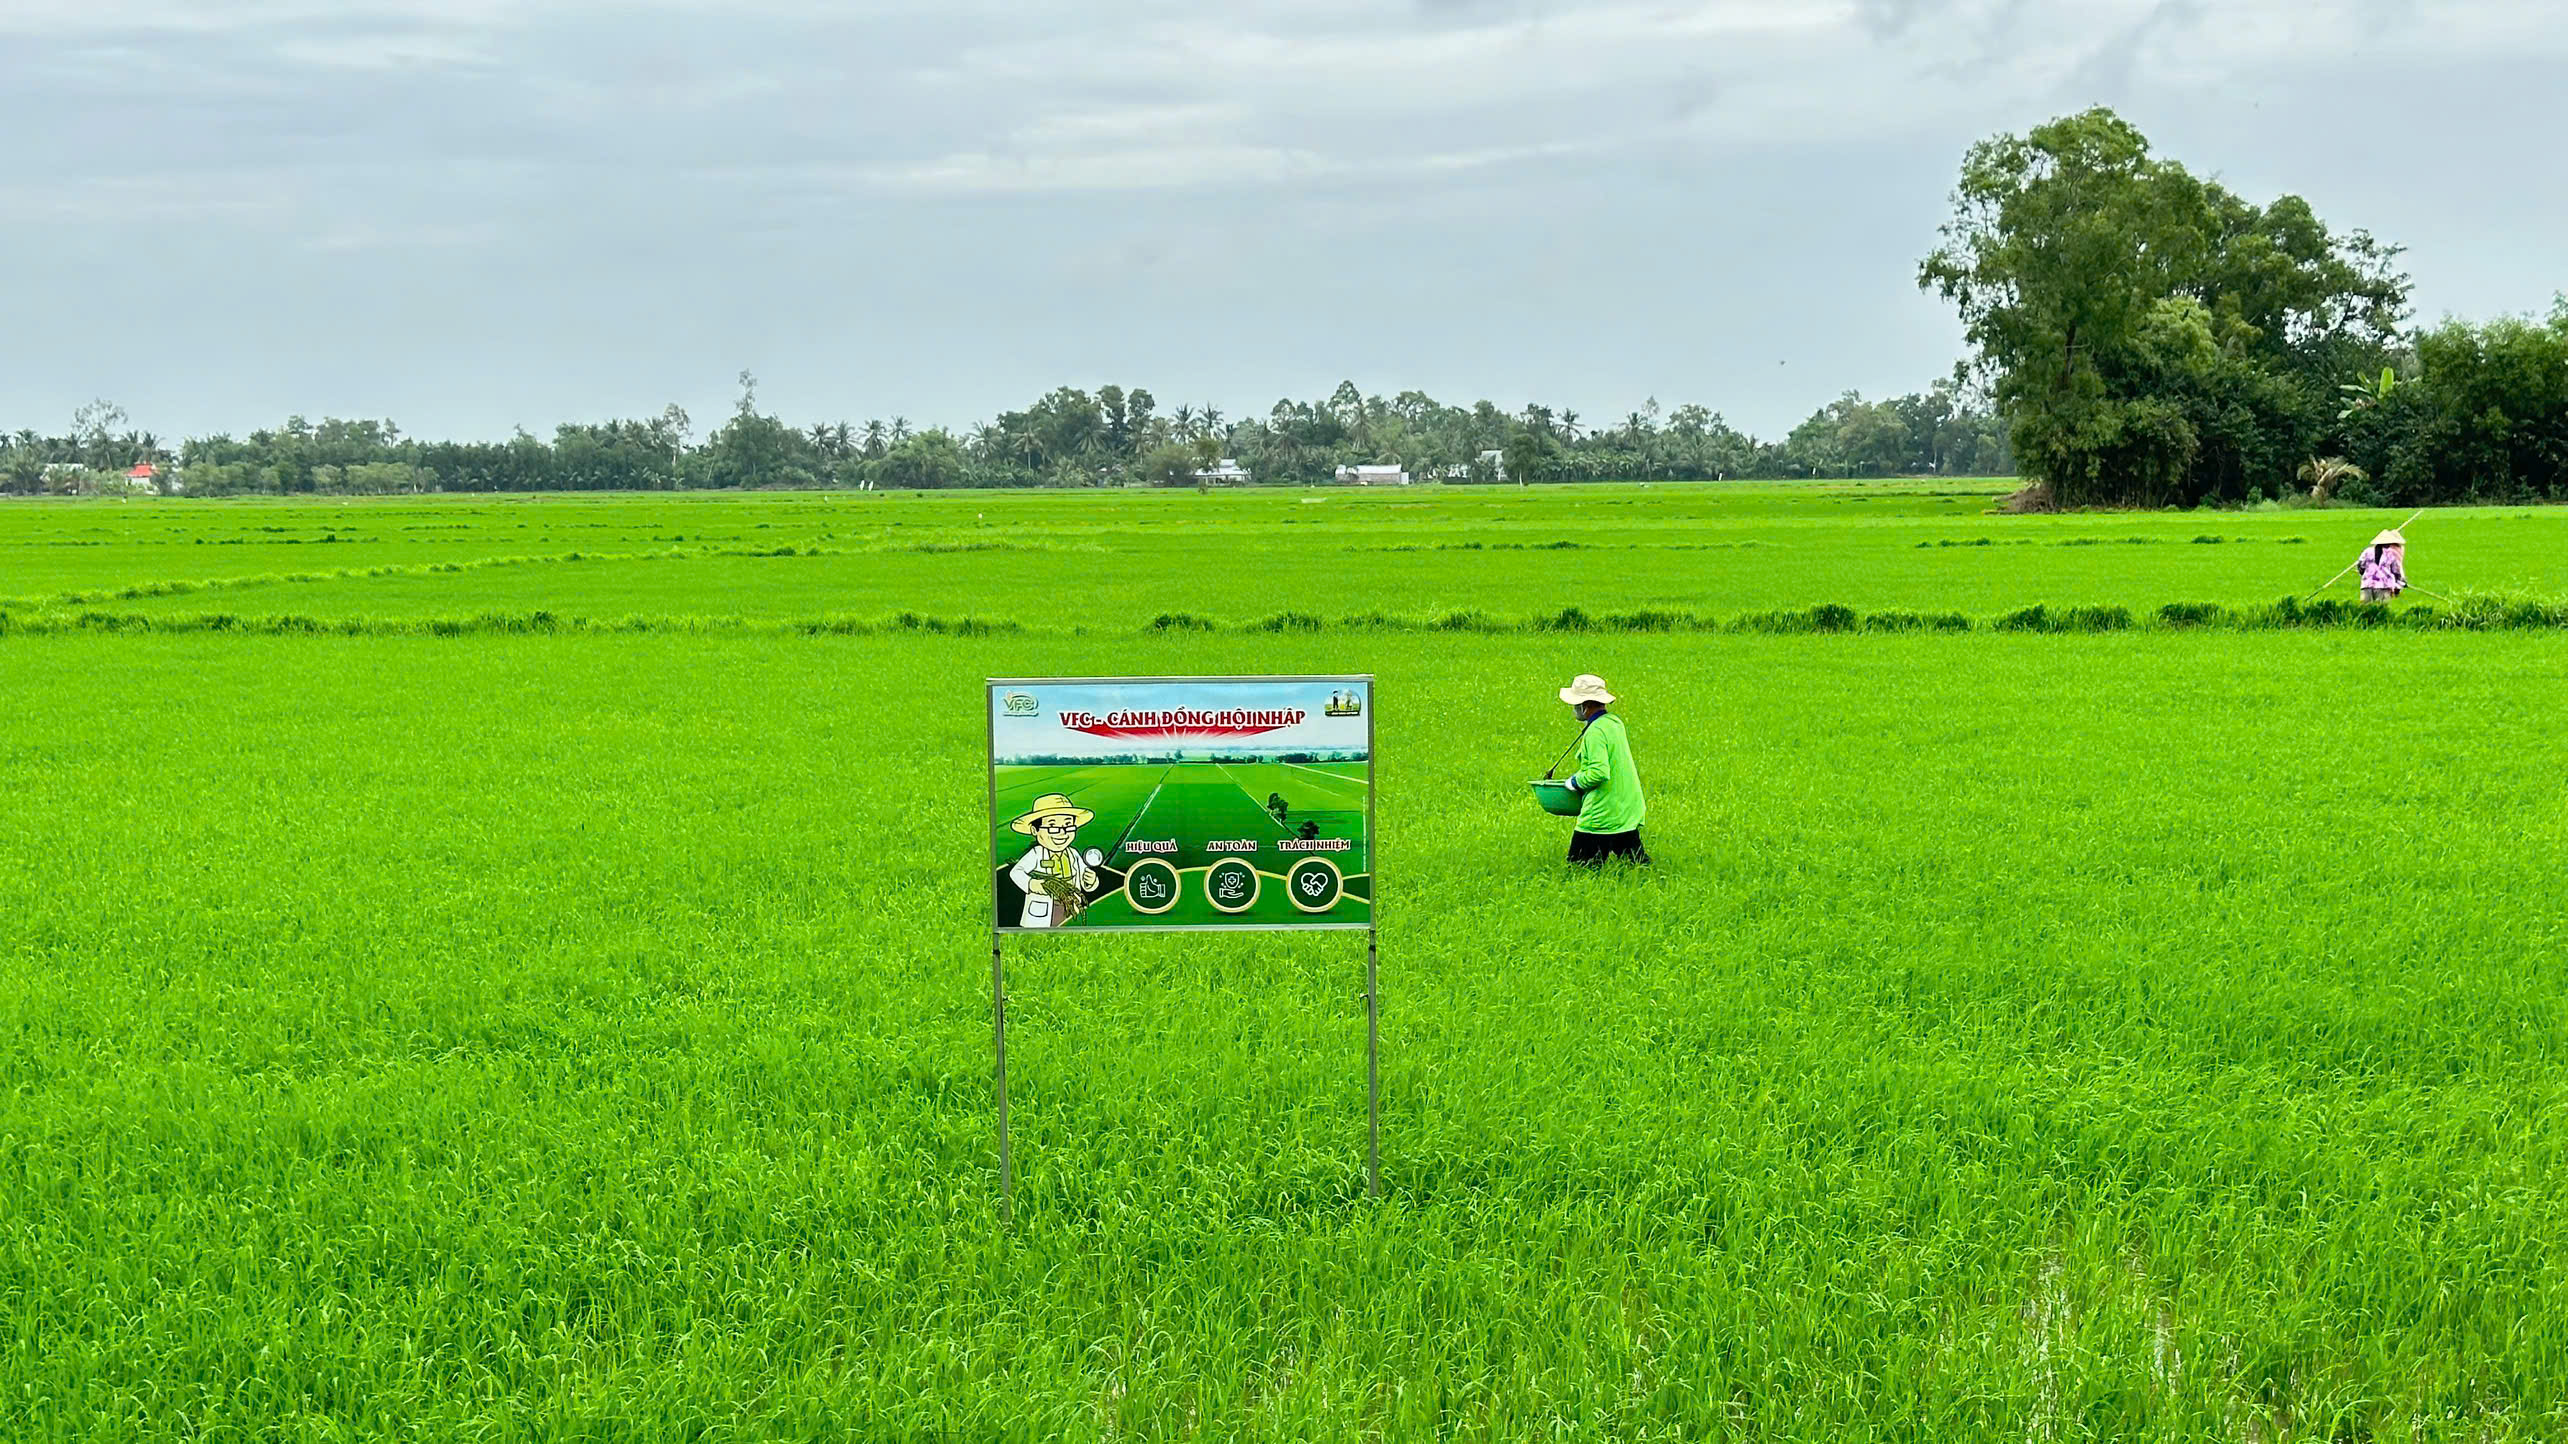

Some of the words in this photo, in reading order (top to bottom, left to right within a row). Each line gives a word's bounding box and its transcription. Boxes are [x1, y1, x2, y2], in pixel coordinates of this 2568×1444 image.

[1003, 698, 1034, 711] VFC
[1059, 711, 1091, 726] VFC
[1107, 708, 1156, 726] CÁNH
[1220, 708, 1252, 728] HỘI
[1257, 707, 1306, 728] NHẬP
[1208, 841, 1224, 851] AN
